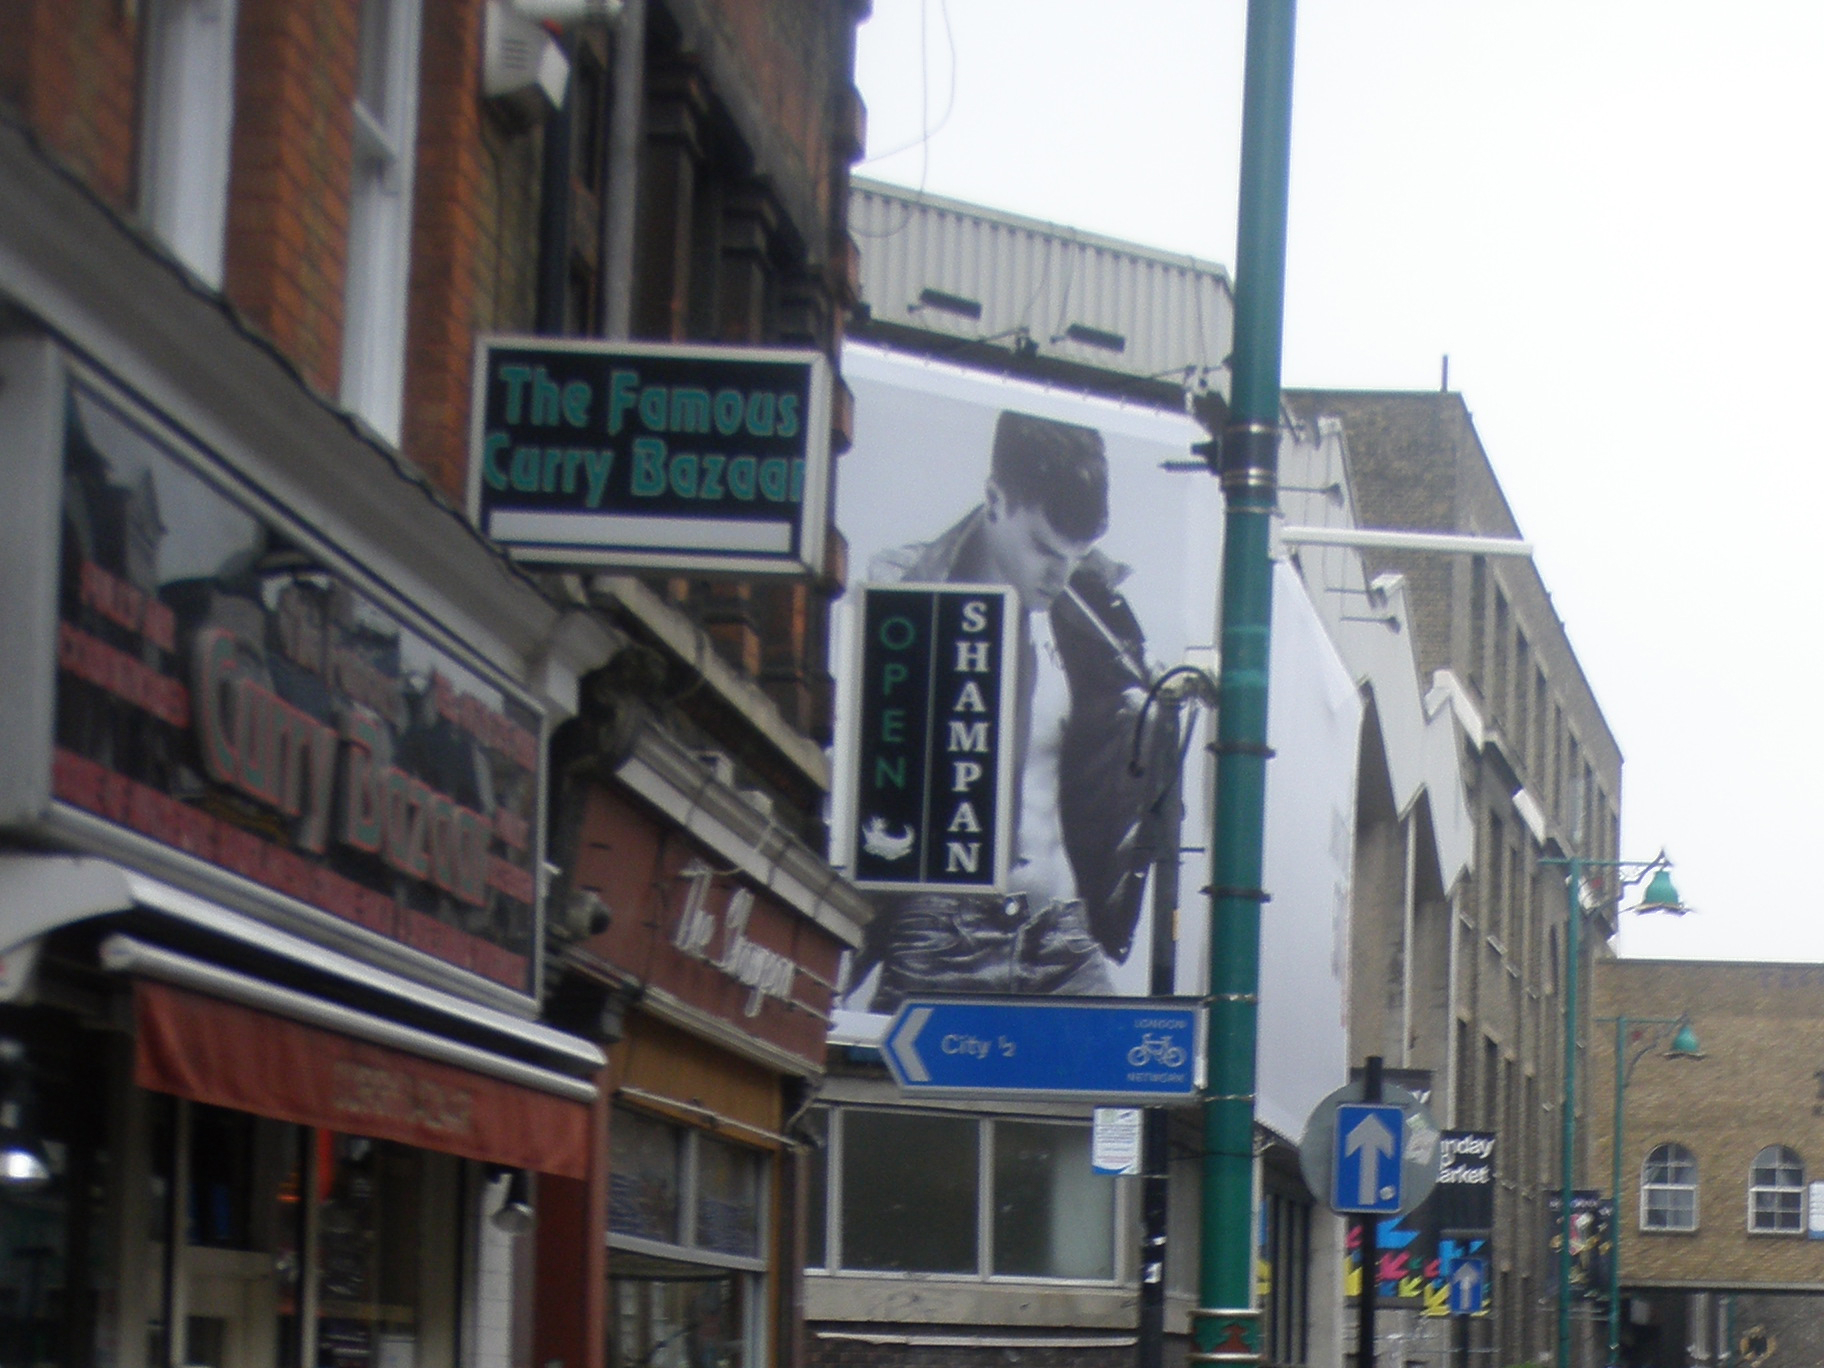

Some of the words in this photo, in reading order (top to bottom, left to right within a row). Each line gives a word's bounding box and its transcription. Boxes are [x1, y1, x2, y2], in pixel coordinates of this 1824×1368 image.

[500, 364, 592, 428] The
[608, 370, 799, 437] Famous
[483, 432, 615, 508] Curry
[630, 437, 806, 502] Bazaar
[875, 617, 915, 789] OPEN
[944, 601, 991, 874] SHAMPAN
[941, 1033, 991, 1059] City
[1436, 1163, 1489, 1184] arket
[1440, 1134, 1496, 1159] nday
